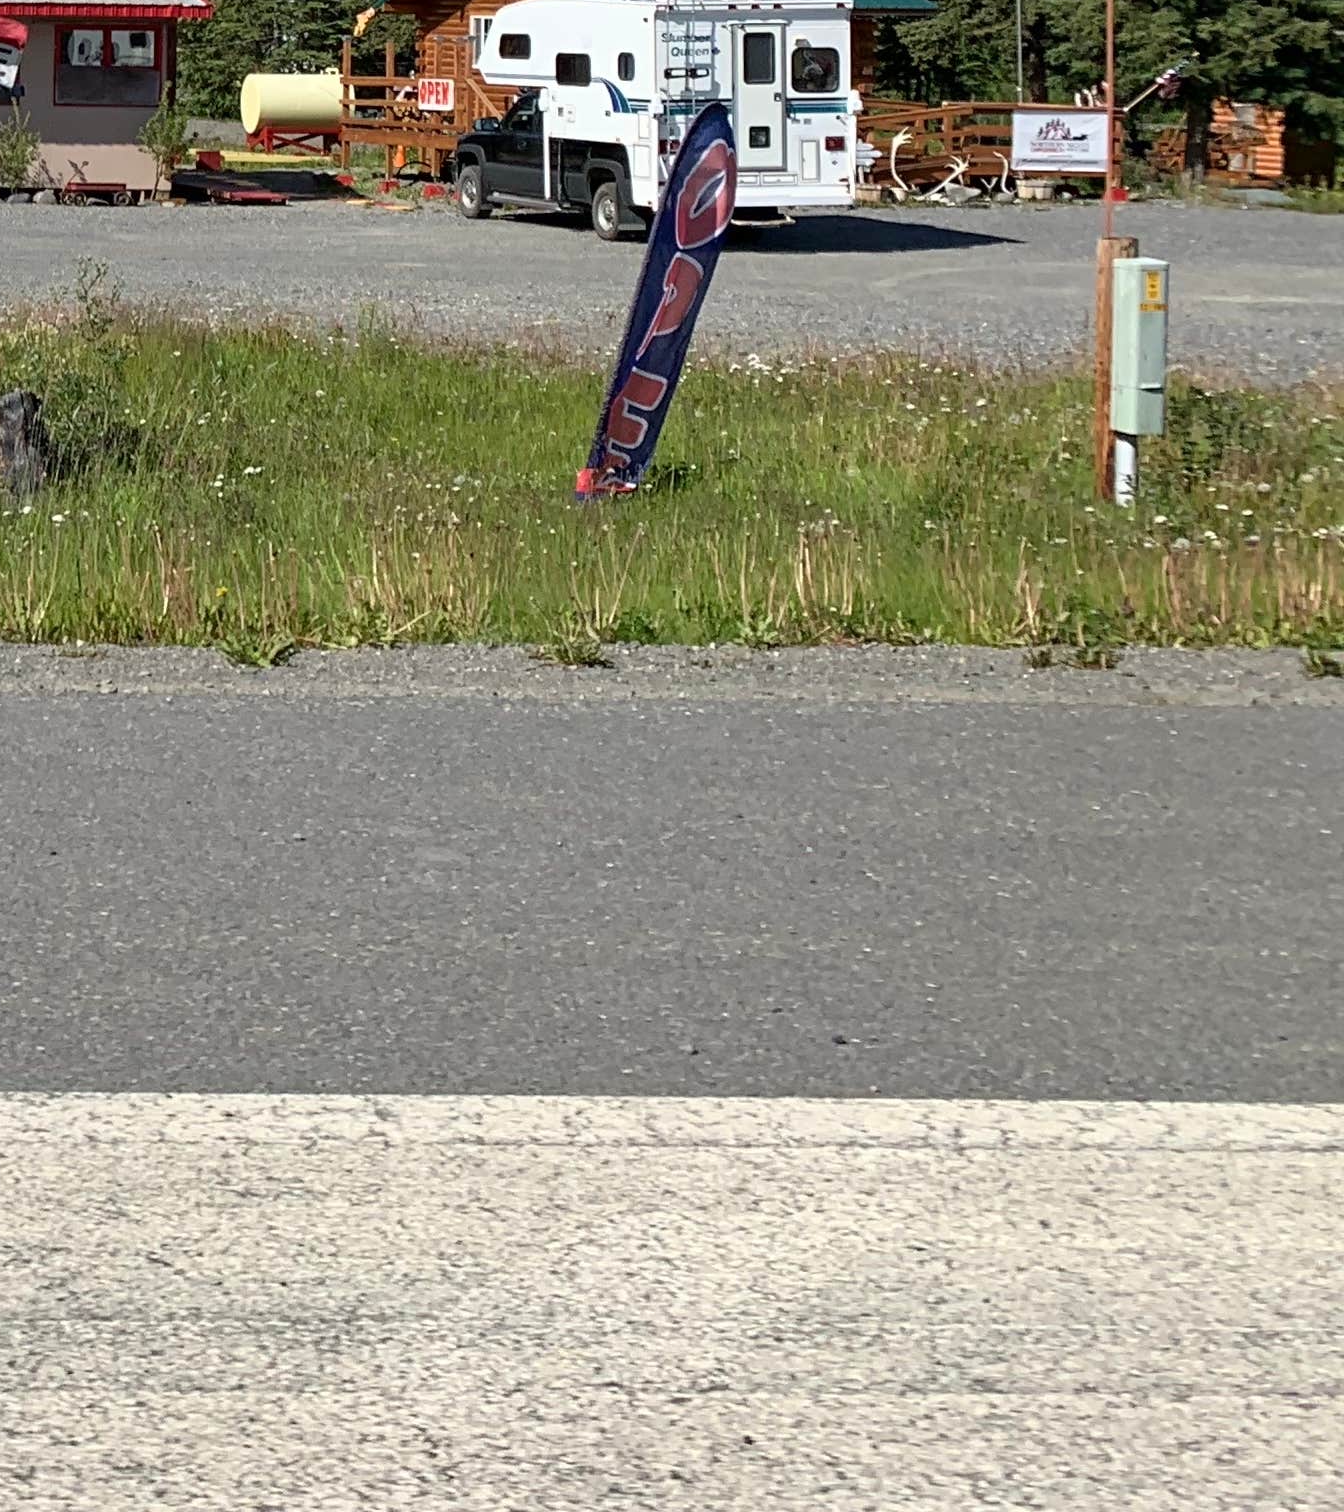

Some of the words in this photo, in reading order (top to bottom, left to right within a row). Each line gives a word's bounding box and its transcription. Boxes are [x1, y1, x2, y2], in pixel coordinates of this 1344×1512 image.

[671, 47, 709, 56] Queen
[419, 81, 450, 105] OPEN
[600, 138, 738, 491] OPE
